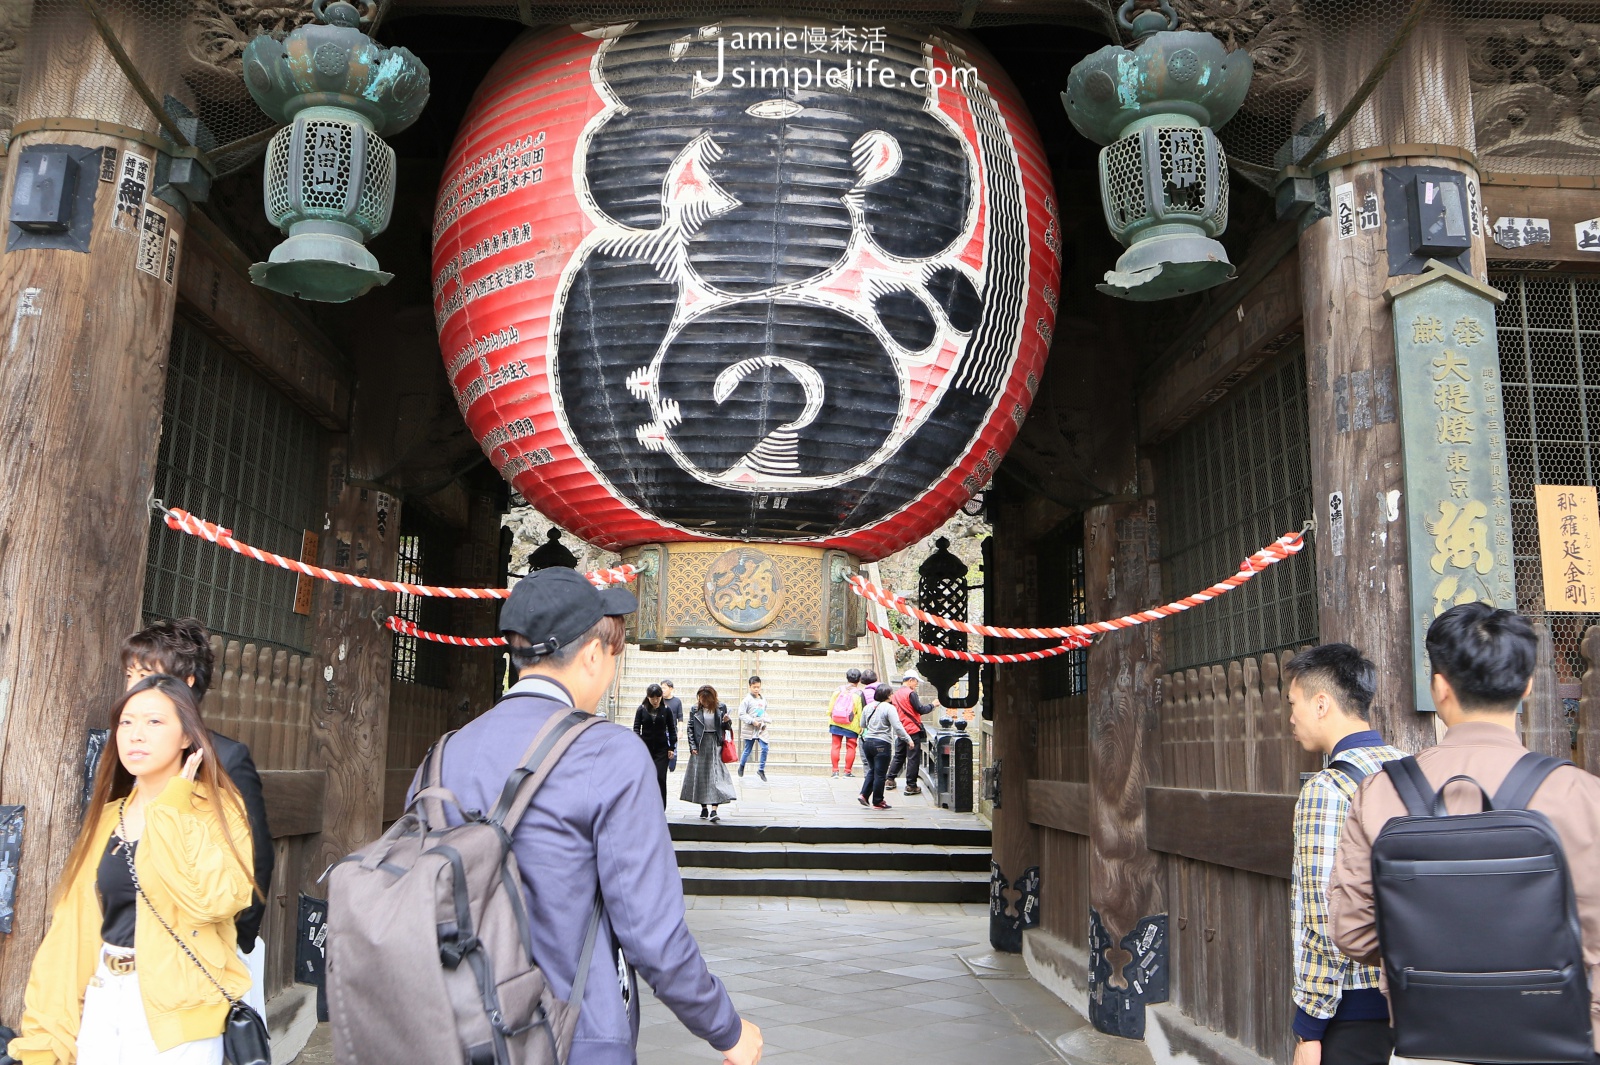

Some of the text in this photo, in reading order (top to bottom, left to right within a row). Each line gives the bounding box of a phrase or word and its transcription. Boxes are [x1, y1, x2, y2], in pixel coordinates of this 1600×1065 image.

[315, 132, 338, 186] 成田山
[1557, 492, 1588, 606] 那羅延金剛
